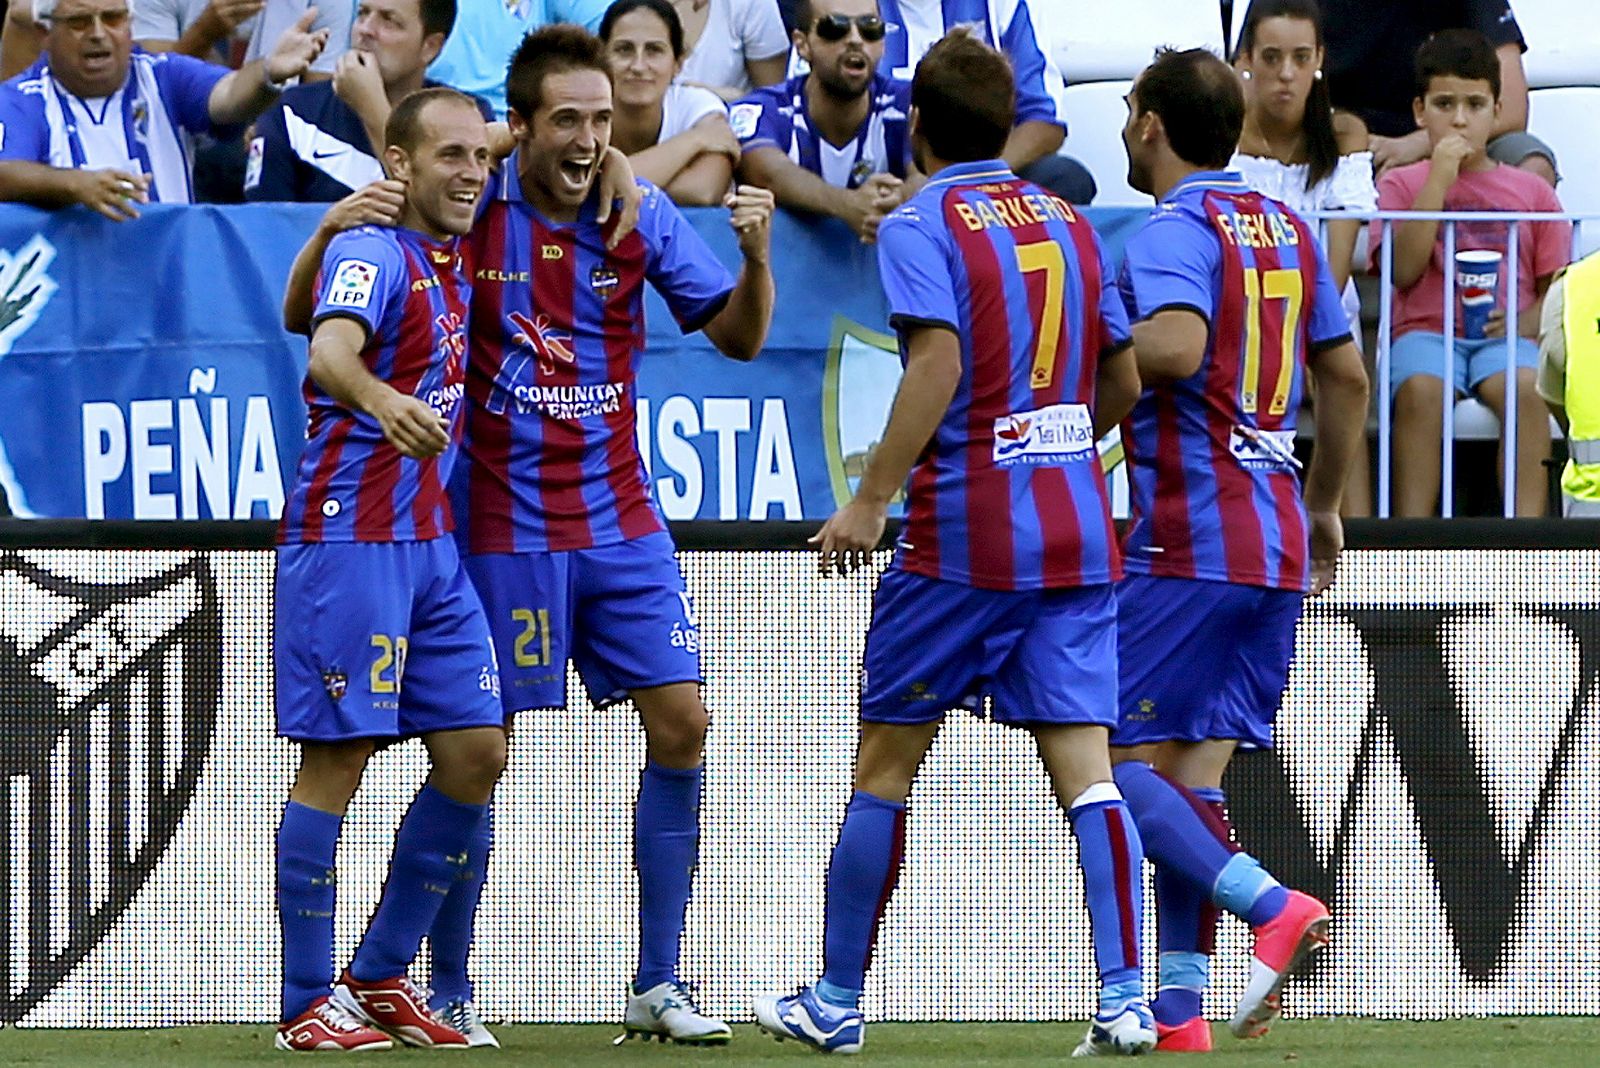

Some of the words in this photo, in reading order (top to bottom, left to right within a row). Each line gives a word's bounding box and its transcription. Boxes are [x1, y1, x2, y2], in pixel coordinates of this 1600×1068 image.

[954, 195, 1077, 232] BARKERO
[333, 290, 365, 304] LFP
[1014, 240, 1066, 390] 7
[1242, 267, 1303, 416] 17
[82, 367, 286, 520] PEÑA
[511, 608, 551, 667] 21
